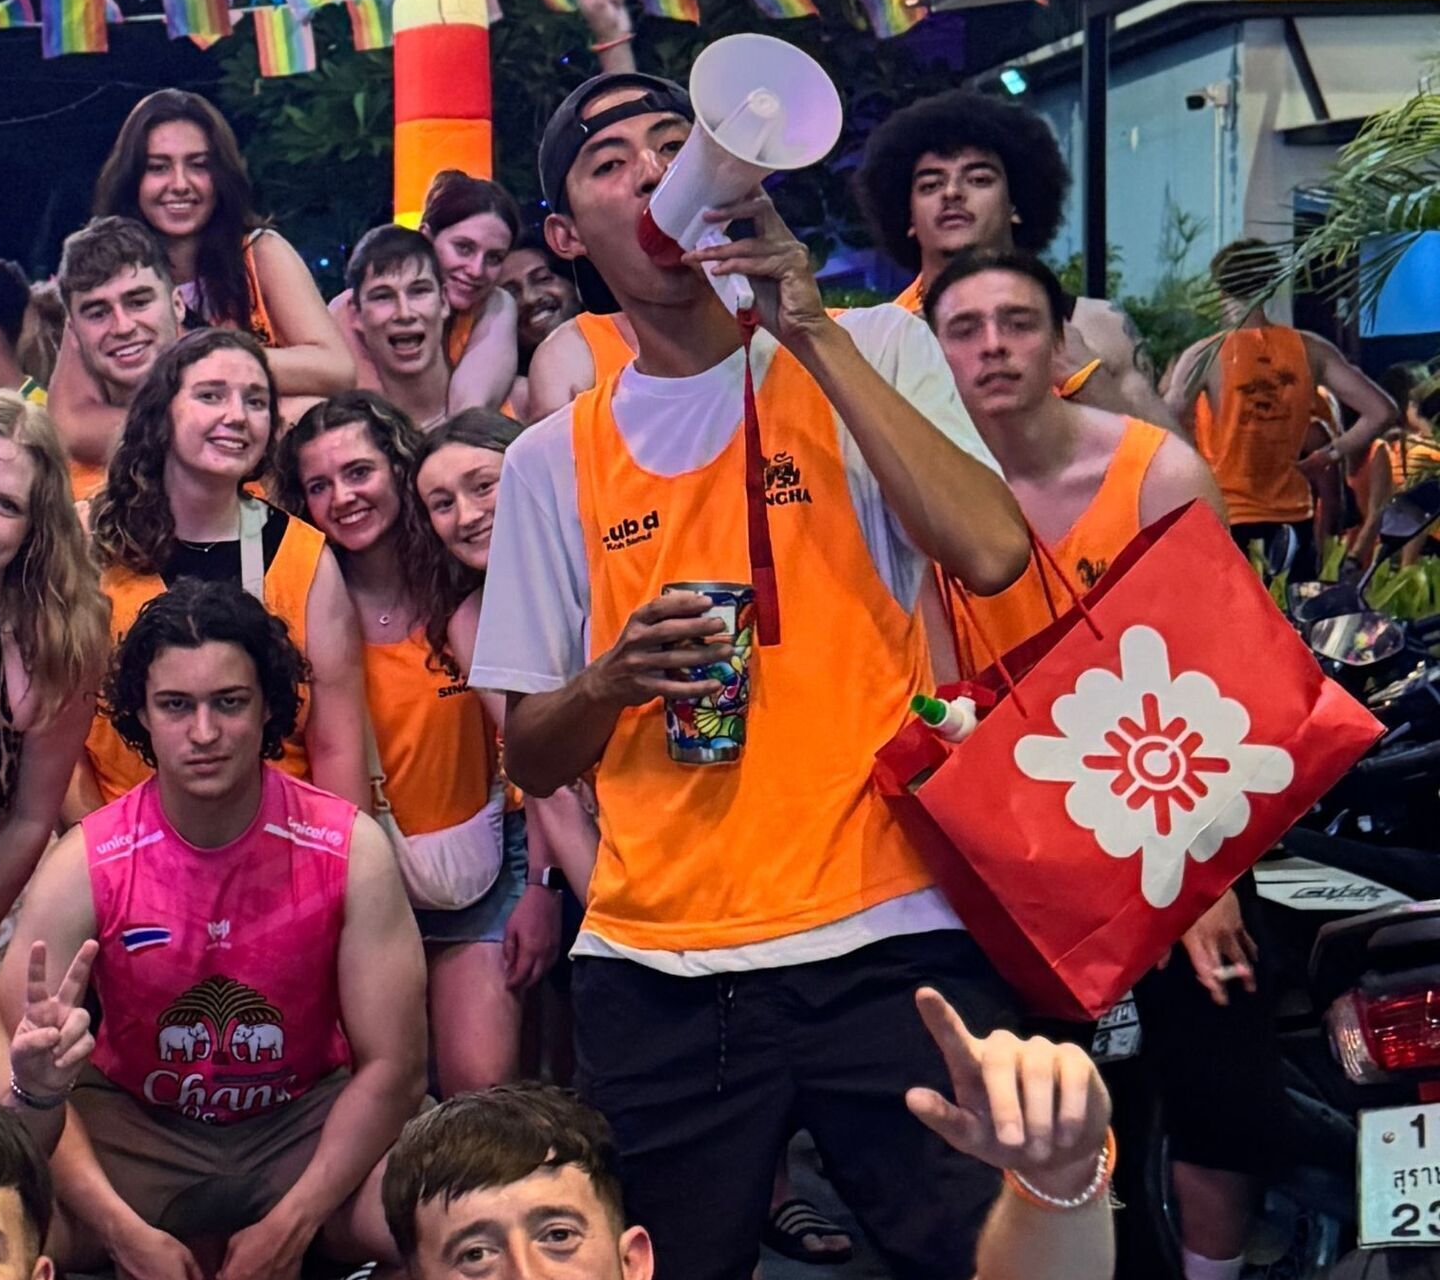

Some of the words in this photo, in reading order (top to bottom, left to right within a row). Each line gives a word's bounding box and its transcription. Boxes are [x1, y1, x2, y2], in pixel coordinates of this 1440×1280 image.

[765, 488, 813, 506] NGHA
[602, 519, 639, 544] ub
[96, 832, 137, 854] unice
